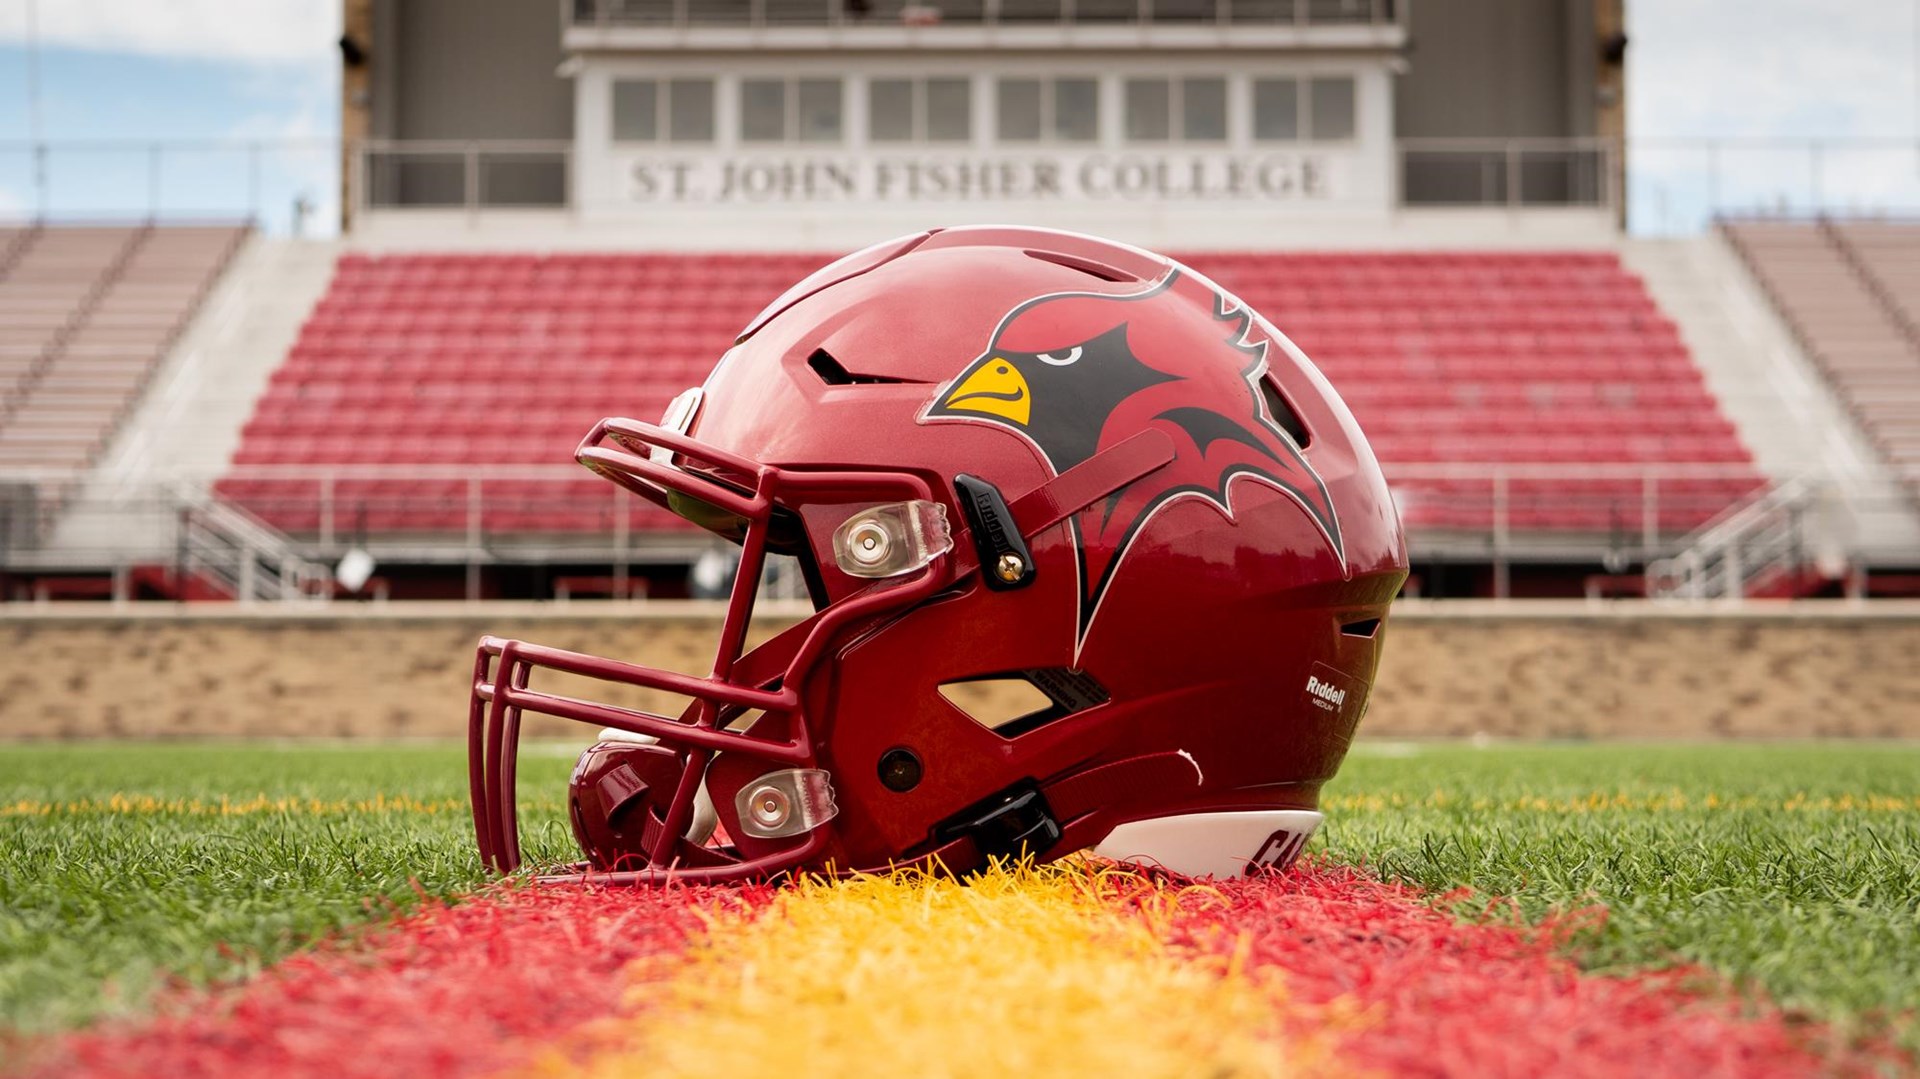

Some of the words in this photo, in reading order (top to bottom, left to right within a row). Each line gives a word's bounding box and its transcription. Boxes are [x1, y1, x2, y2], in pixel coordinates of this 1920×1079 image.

[718, 159, 857, 200] JOHN
[875, 159, 1062, 200] FISHER
[1079, 157, 1329, 200] COLLEGE
[977, 493, 1011, 553] Riddell
[1306, 675, 1346, 705] Riddell
[1312, 698, 1334, 711] MEDIUM
